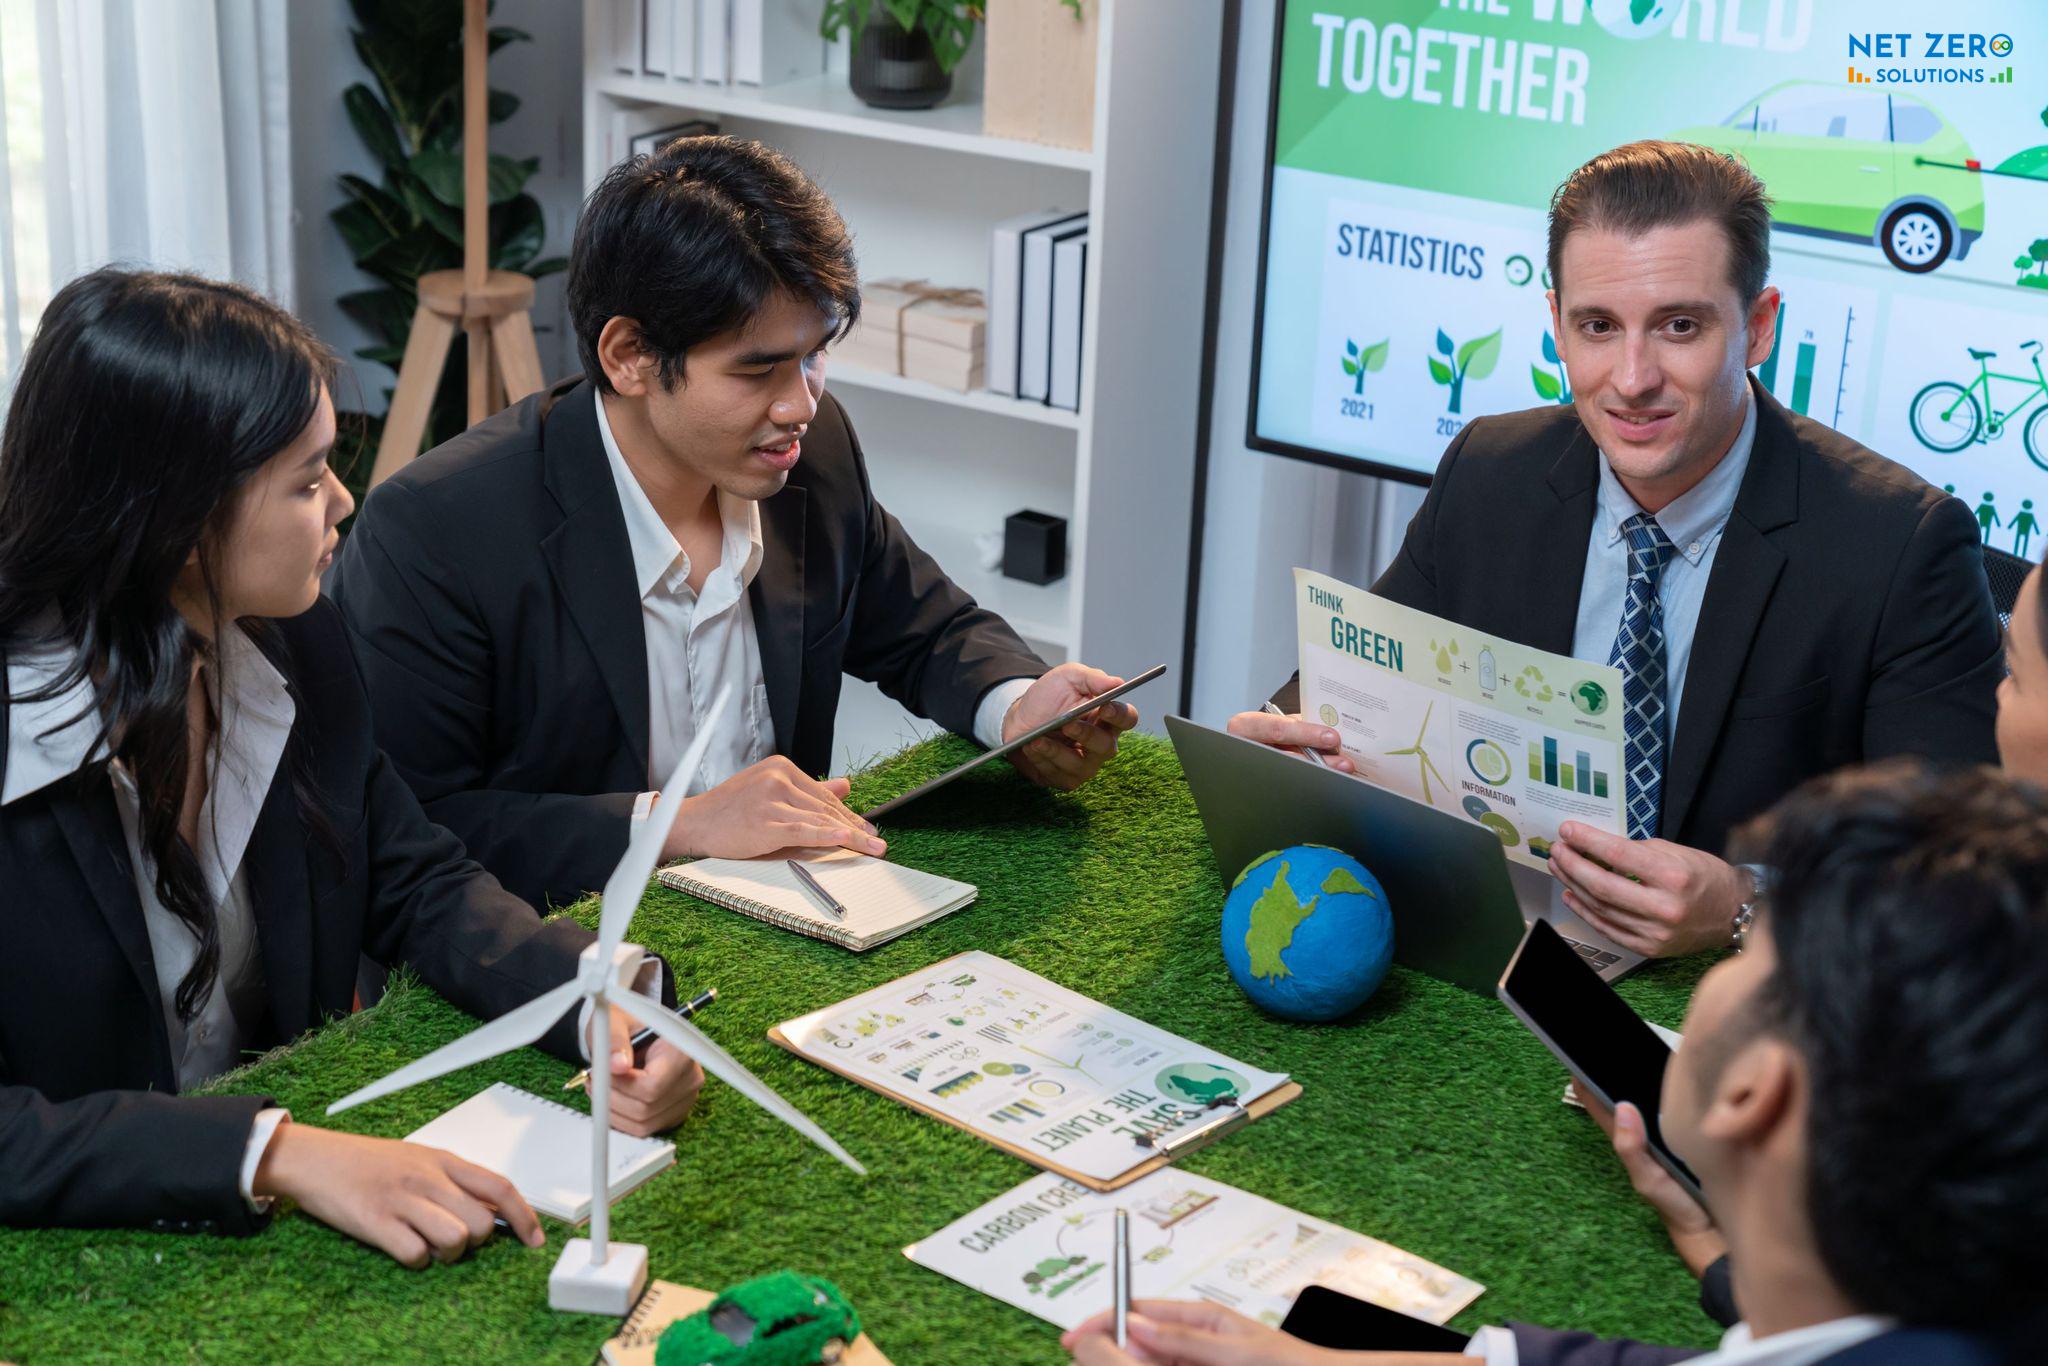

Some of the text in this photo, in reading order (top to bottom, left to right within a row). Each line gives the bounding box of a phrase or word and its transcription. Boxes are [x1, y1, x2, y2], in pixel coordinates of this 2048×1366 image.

[1311, 12, 1590, 126] TOGETHER
[1337, 222, 1485, 280] STATISTICS
[1340, 397, 1374, 420] 2021
[1436, 416, 1467, 437] 202
[1307, 584, 1344, 615] THINK
[1331, 616, 1404, 673] GREEN
[1461, 780, 1516, 807] INFORMATION
[1031, 1088, 1157, 1152] THE PLANET
[959, 1180, 1090, 1254] CARBON CRE
